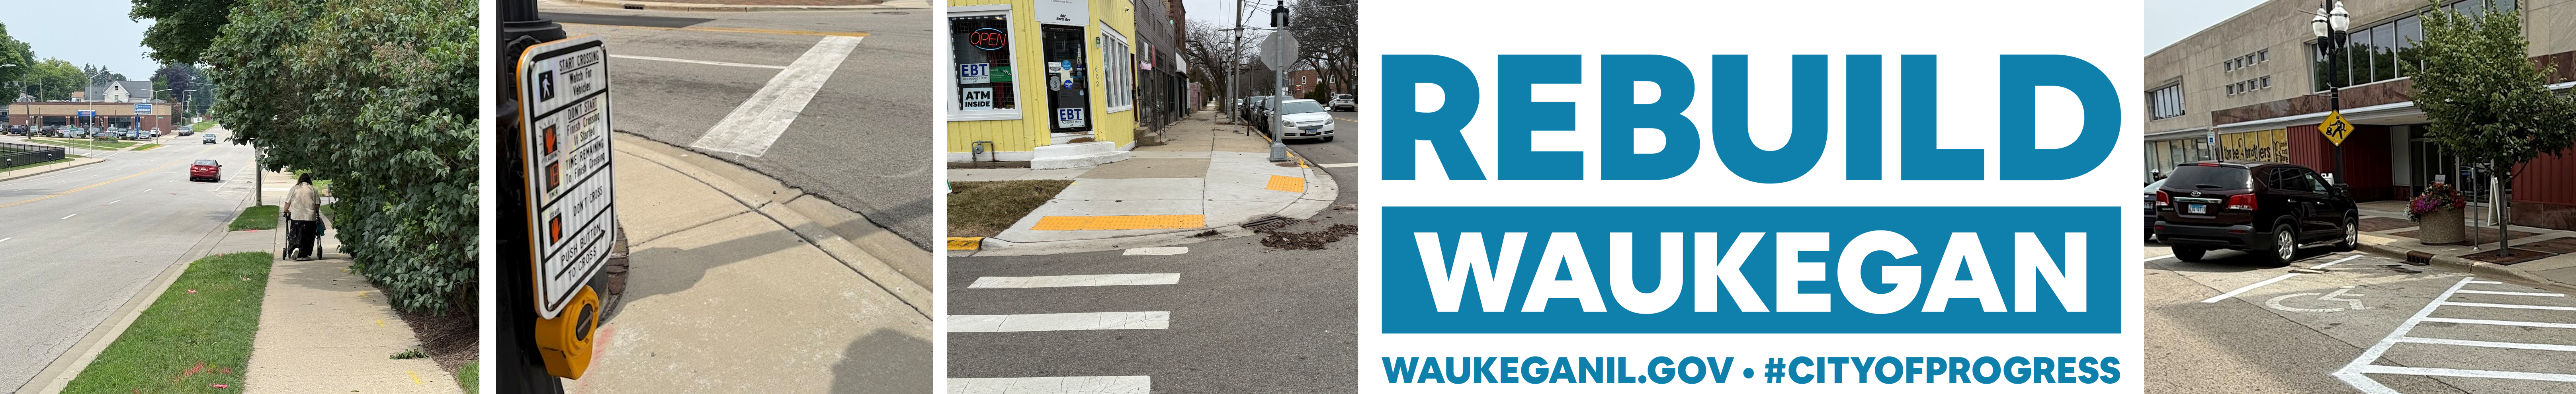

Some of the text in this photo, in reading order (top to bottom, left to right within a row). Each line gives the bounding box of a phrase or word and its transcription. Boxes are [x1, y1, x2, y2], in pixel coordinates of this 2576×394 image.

[970, 32, 1007, 46] OPEN
[559, 50, 599, 72] START CROSSING
[962, 64, 987, 76] EBT
[569, 71, 583, 84] Watch
[573, 82, 591, 96] Vehicles
[966, 91, 990, 100] ATM
[568, 97, 597, 120] DON'T START
[1060, 109, 1081, 120] EBT
[567, 113, 600, 137] Finish Crossing
[574, 126, 595, 146] If Started
[565, 139, 604, 170] TIME REMAINING
[2224, 146, 2239, 160] three
[566, 153, 605, 184] To Finish Crossing
[573, 186, 603, 217] DON'T CROSS
[561, 222, 600, 266] PUSH BUTTON
[568, 246, 597, 281] TO CROSS
